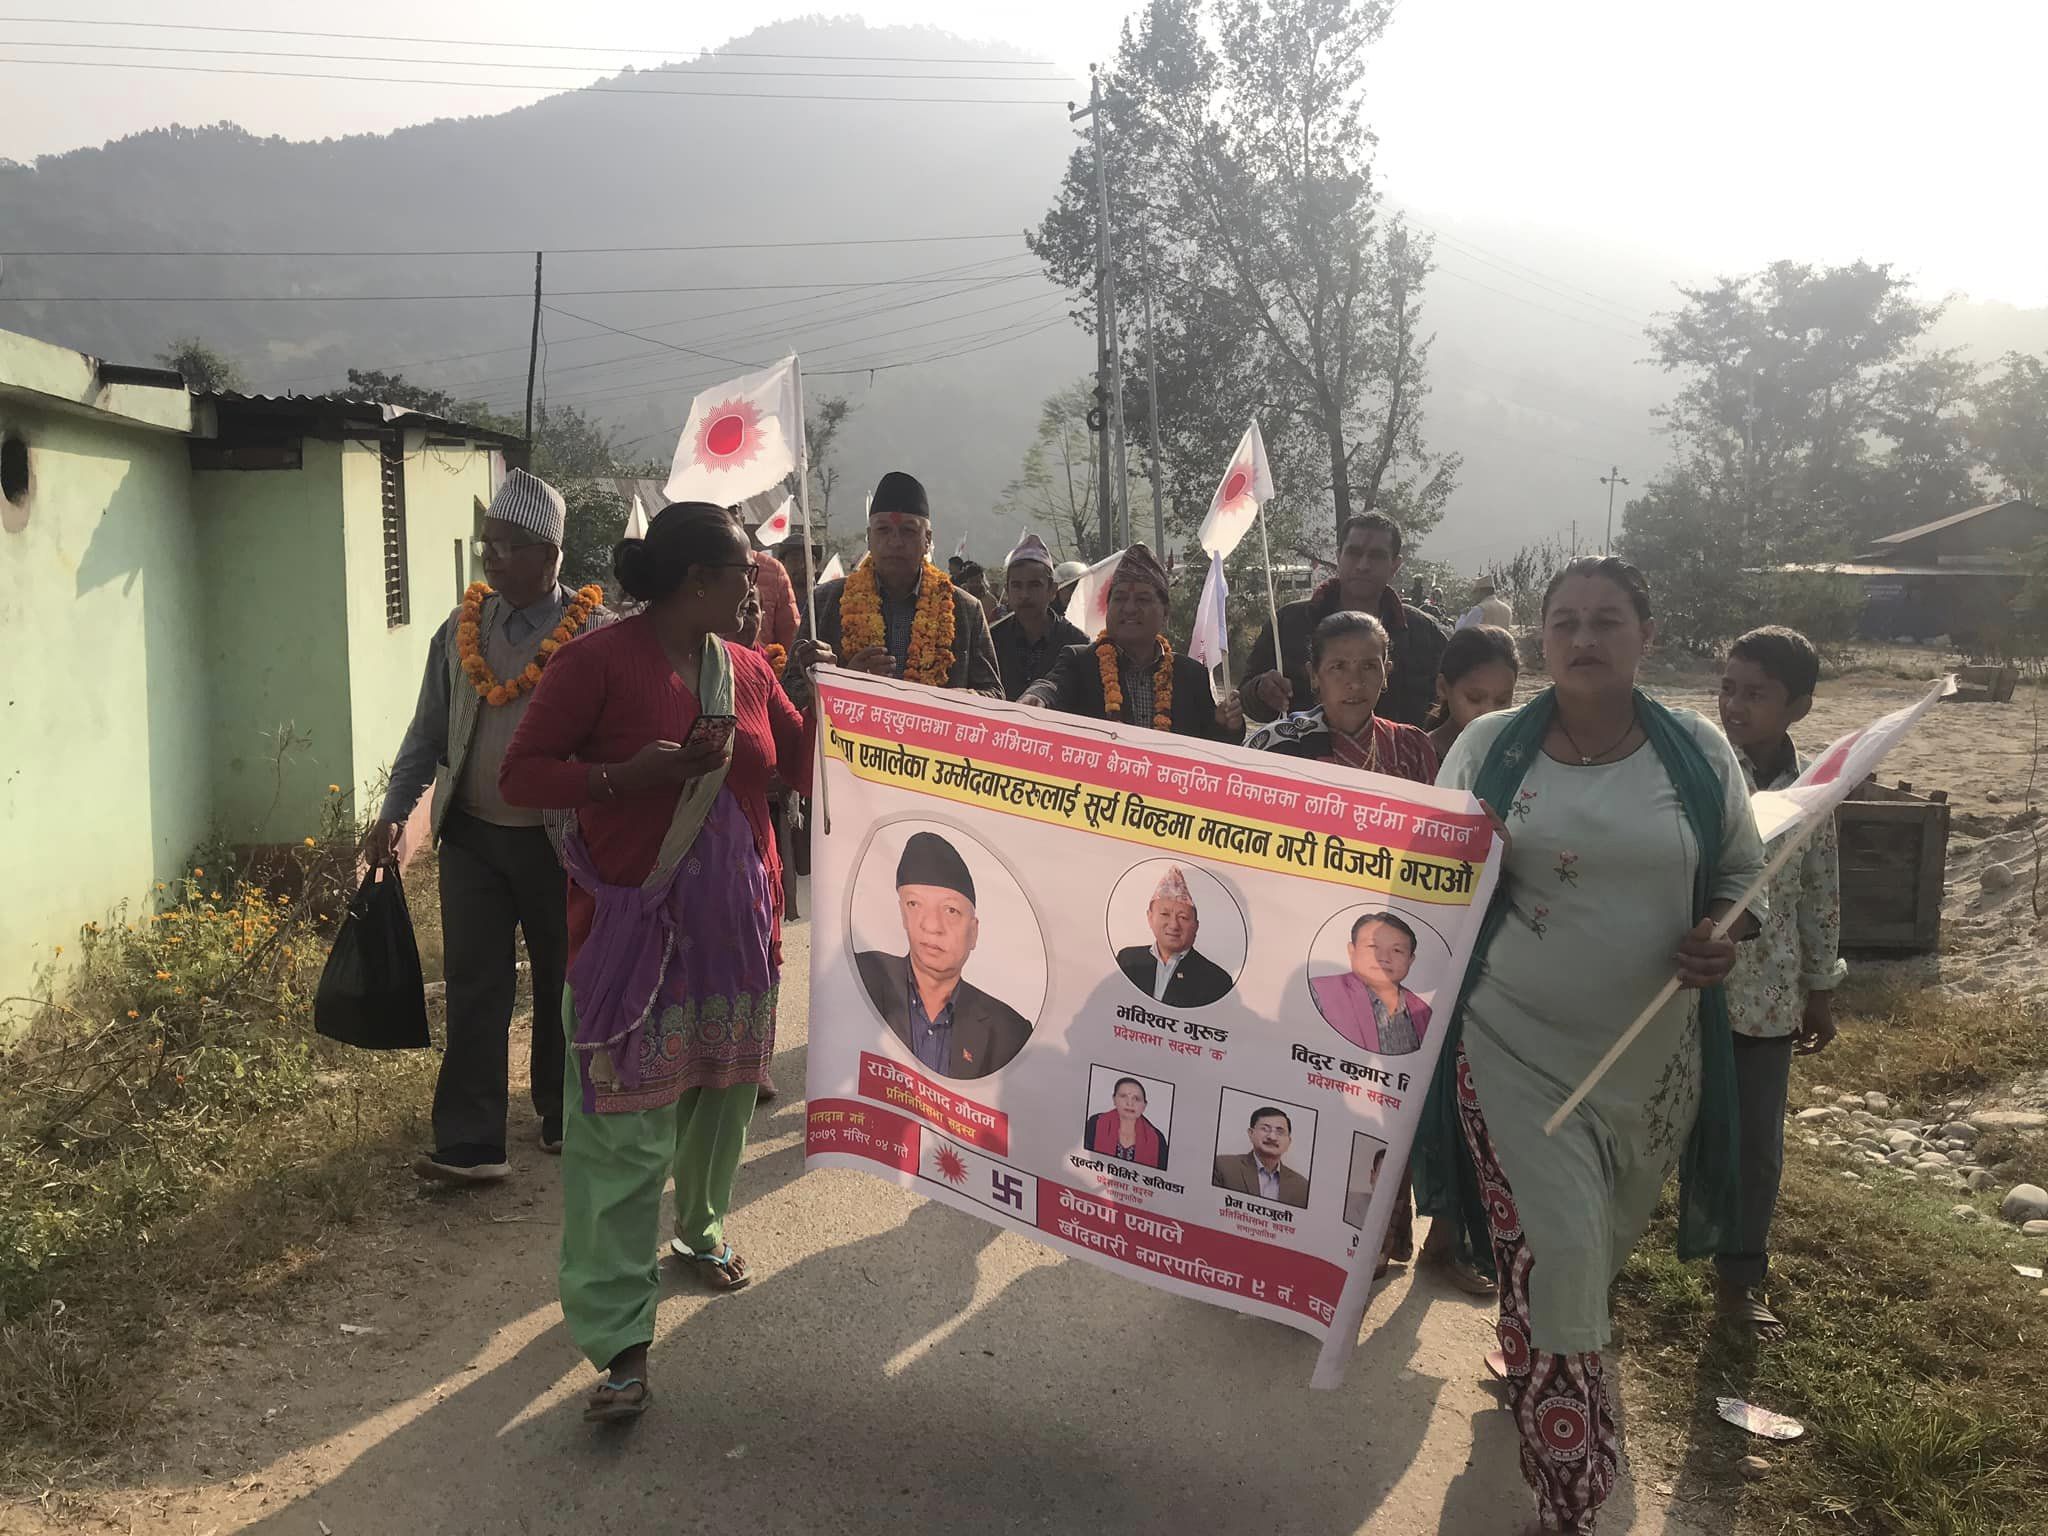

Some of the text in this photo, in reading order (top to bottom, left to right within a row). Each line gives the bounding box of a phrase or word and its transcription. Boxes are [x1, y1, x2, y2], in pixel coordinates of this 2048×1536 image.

[955, 722, 989, 745] हाम्रो
[992, 729, 1054, 762] अभियान,
[1061, 745, 1102, 769] समग्र
[1106, 751, 1152, 779] क्षेत्रको
[1157, 765, 1222, 796] सन्तुलित
[1226, 773, 1300, 809] विकासका
[1304, 793, 1349, 819] लागि
[1353, 803, 1407, 832] सूर्यमा
[859, 744, 929, 780] एमालेका
[1084, 792, 1120, 829] सूर्य
[1121, 793, 1196, 840] चिन्हमा
[1198, 818, 1272, 857] मतदान
[1276, 831, 1318, 866] गरी
[1324, 835, 1394, 880] विजयी
[1113, 1024, 1164, 1048] प्रदेशसभा
[1168, 1039, 1203, 1056] सदस्य
[1116, 1005, 1180, 1033] भविश्वर
[1291, 1043, 1336, 1070] विदुर
[1339, 1059, 1394, 1087] कुमार
[867, 1059, 996, 1129] राजेन्द्र प्रसाद गौतम
[1307, 1072, 1402, 1110] प्रदेशसभा सदस्य
[809, 1111, 845, 1124] मतदान
[885, 1087, 977, 1139] प्रतिनिधिसभा सदस्य
[809, 1127, 909, 1159] २०७९ मंसिर ०४ गते
[1069, 1154, 1105, 1173] सुन्दरी
[1142, 1174, 1185, 1195] खतिवडा
[1059, 1189, 1185, 1244] नेकपा एमाले
[1225, 1194, 1294, 1222] प्रेम पराजुली
[1056, 1217, 1128, 1257] खाँदबारी
[1135, 1246, 1244, 1290] नगरपालिका
[1277, 1284, 1297, 1306] नं.
